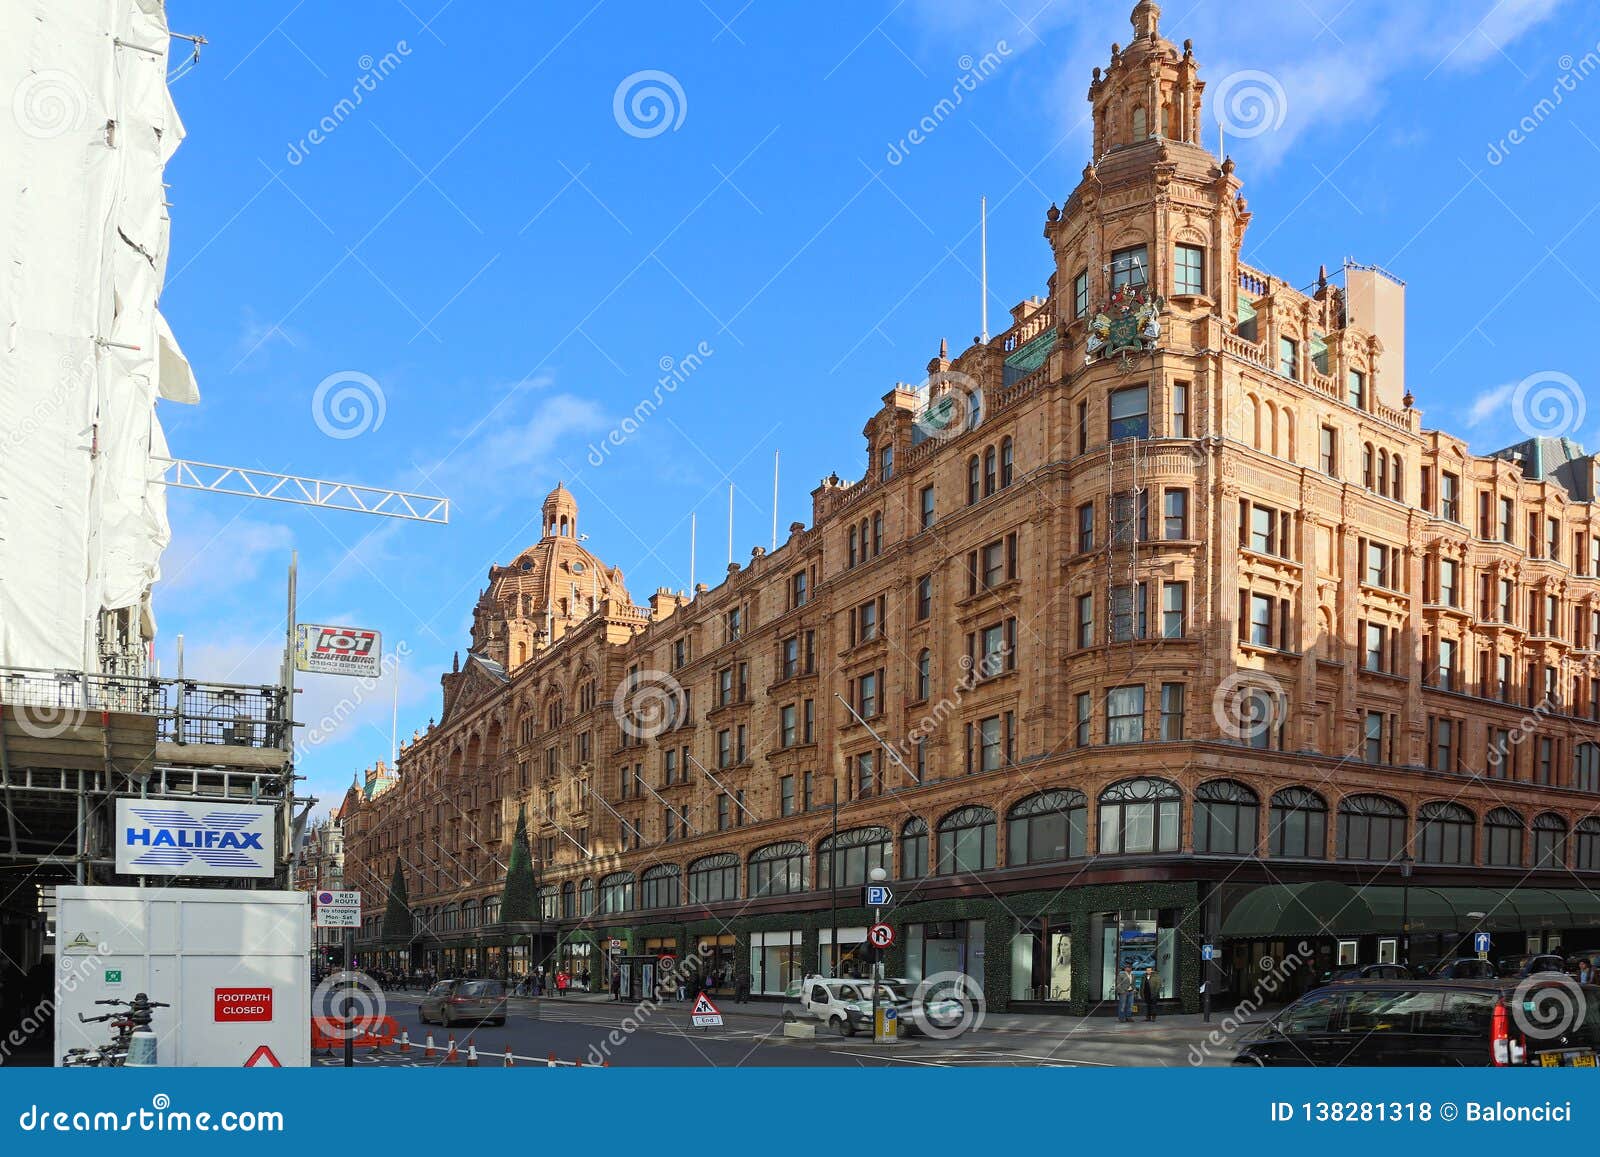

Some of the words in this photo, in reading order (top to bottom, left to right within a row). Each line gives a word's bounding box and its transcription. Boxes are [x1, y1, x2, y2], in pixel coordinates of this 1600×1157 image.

[126, 827, 263, 850] HALIFAX
[216, 994, 270, 1002] FOOTPATH
[223, 1006, 264, 1014] CLOSED
